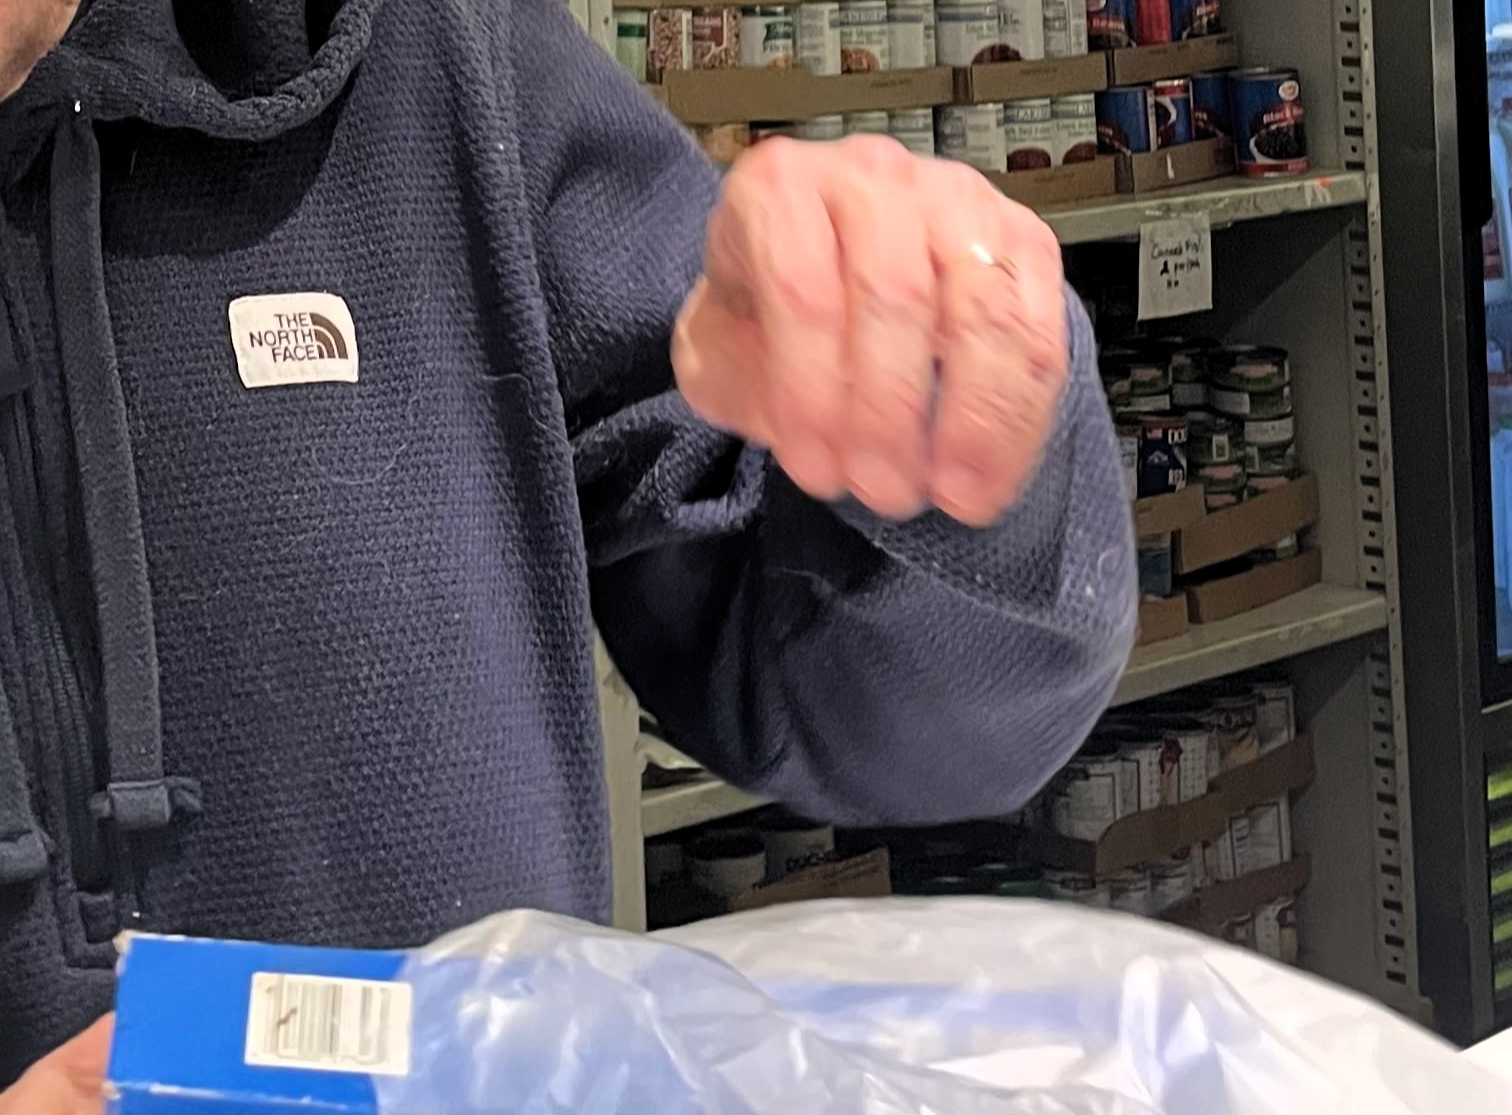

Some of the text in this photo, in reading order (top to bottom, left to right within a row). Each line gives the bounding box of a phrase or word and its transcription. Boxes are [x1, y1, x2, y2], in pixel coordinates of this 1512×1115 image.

[274, 312, 309, 329] THE
[249, 329, 314, 348] NORTH
[271, 344, 315, 364] FACE
